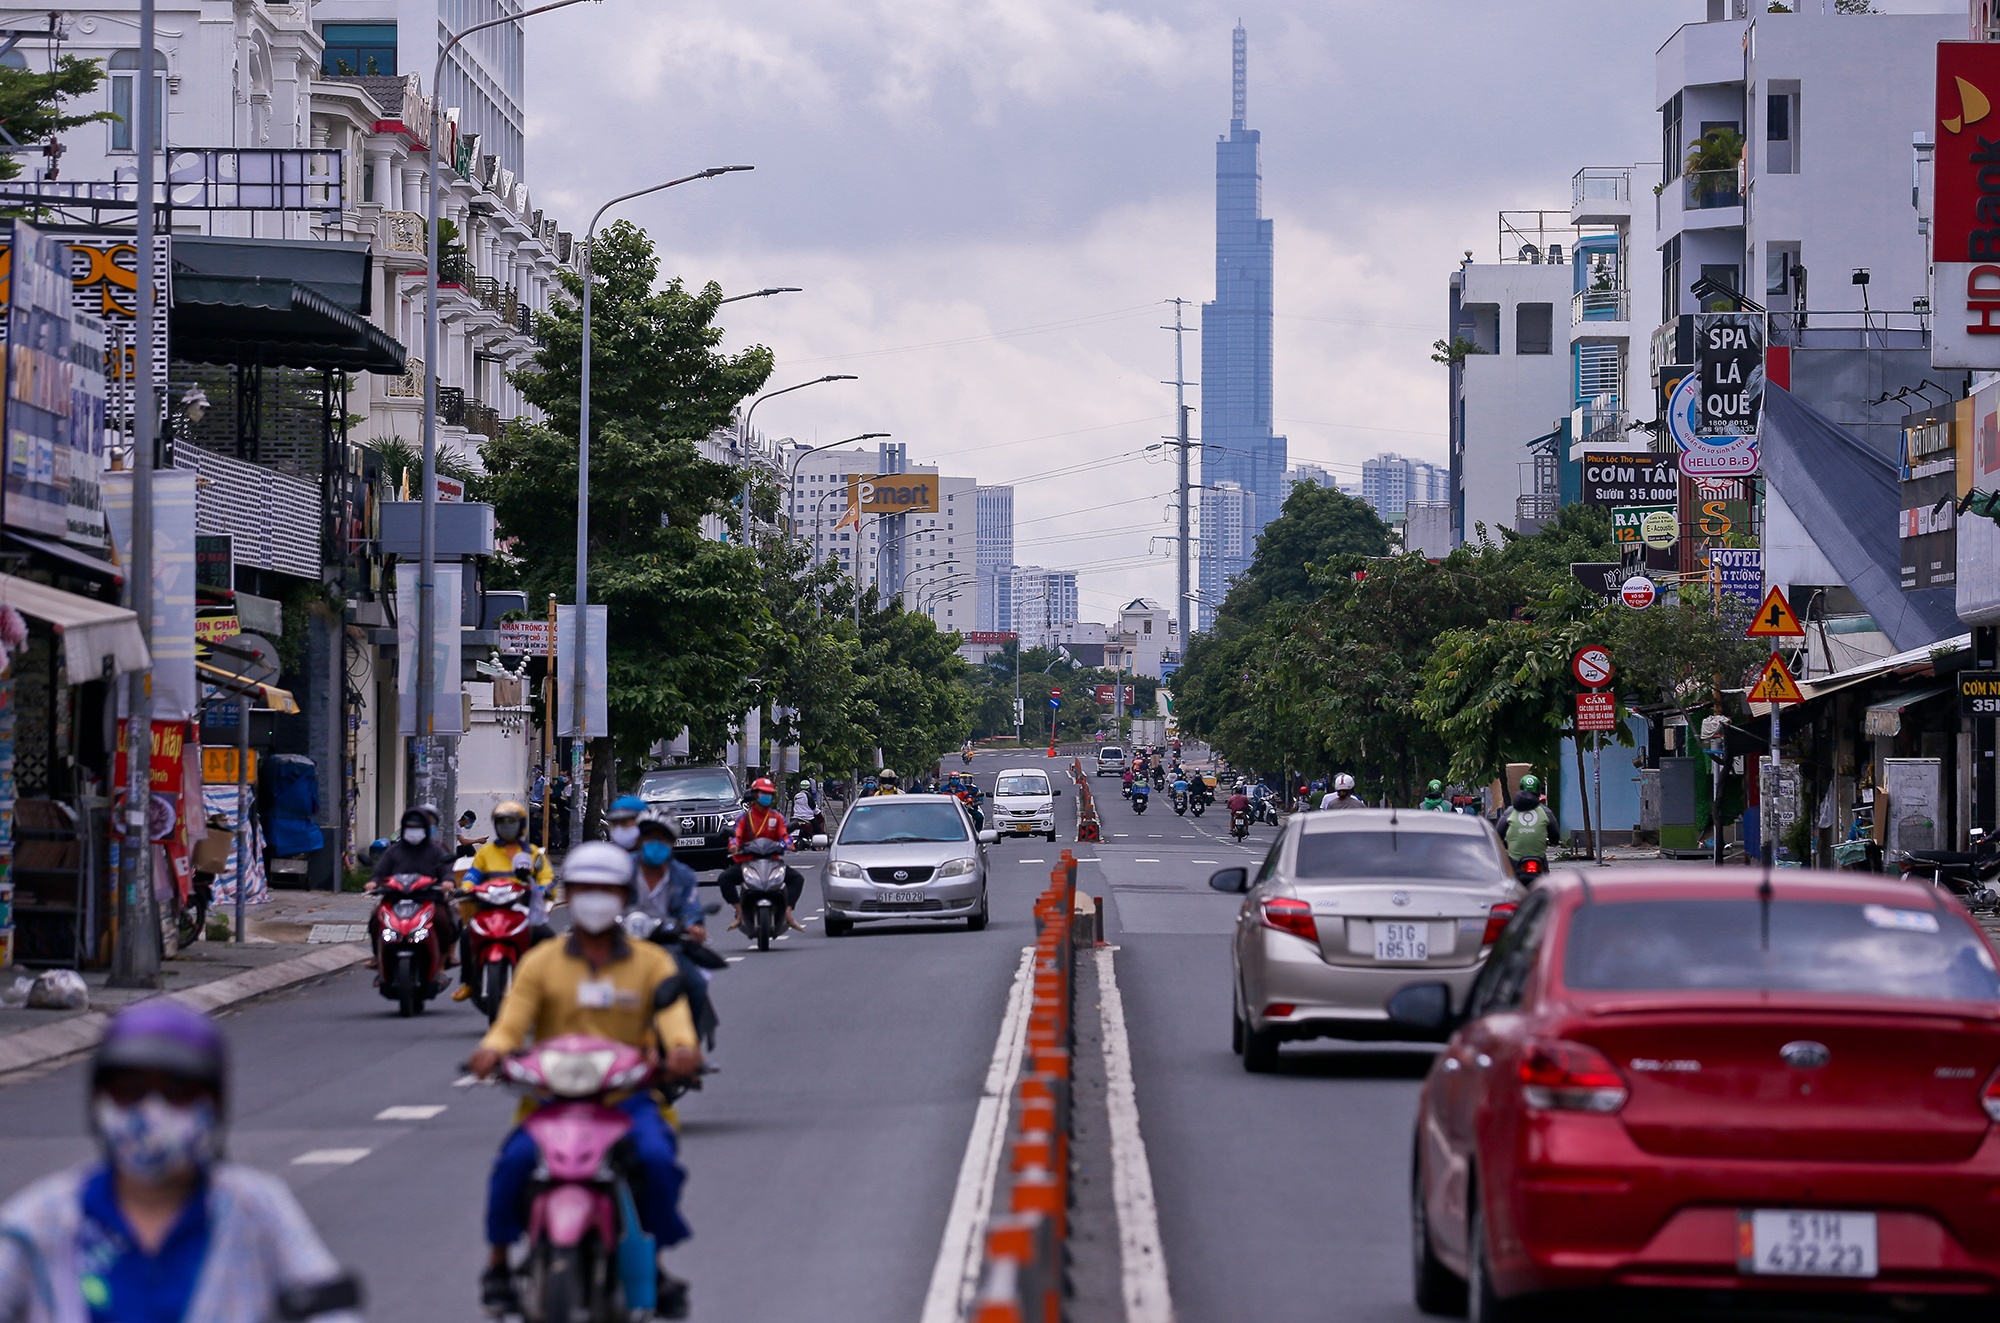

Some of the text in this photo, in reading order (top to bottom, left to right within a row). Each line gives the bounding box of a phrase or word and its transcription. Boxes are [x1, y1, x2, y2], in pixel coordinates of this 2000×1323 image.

[1709, 328, 1747, 350] SPA
[1716, 358, 1741, 384] LÁ
[1707, 389, 1750, 418] QUÊ
[1587, 455, 1604, 463] Phúc
[1605, 455, 1618, 464] Lộc
[1620, 455, 1634, 464] Thọ
[1688, 457, 1726, 467] HELLO
[1587, 464, 1635, 483] CƠM
[859, 482, 930, 505] emart
[1595, 487, 1625, 500] Sườn
[1654, 524, 1674, 532] Acoustic
[196, 538, 226, 551] OTEL
[1712, 551, 1760, 567] HOTEL
[1710, 568, 1761, 581] CT TƯỜNG
[195, 619, 211, 632] ÚN
[1962, 679, 1986, 695] CƠM
[1585, 694, 1606, 704] CẤM
[161, 725, 183, 764] Hấp
[1388, 925, 1416, 942] 51G
[1788, 1213, 1842, 1242] 51H
